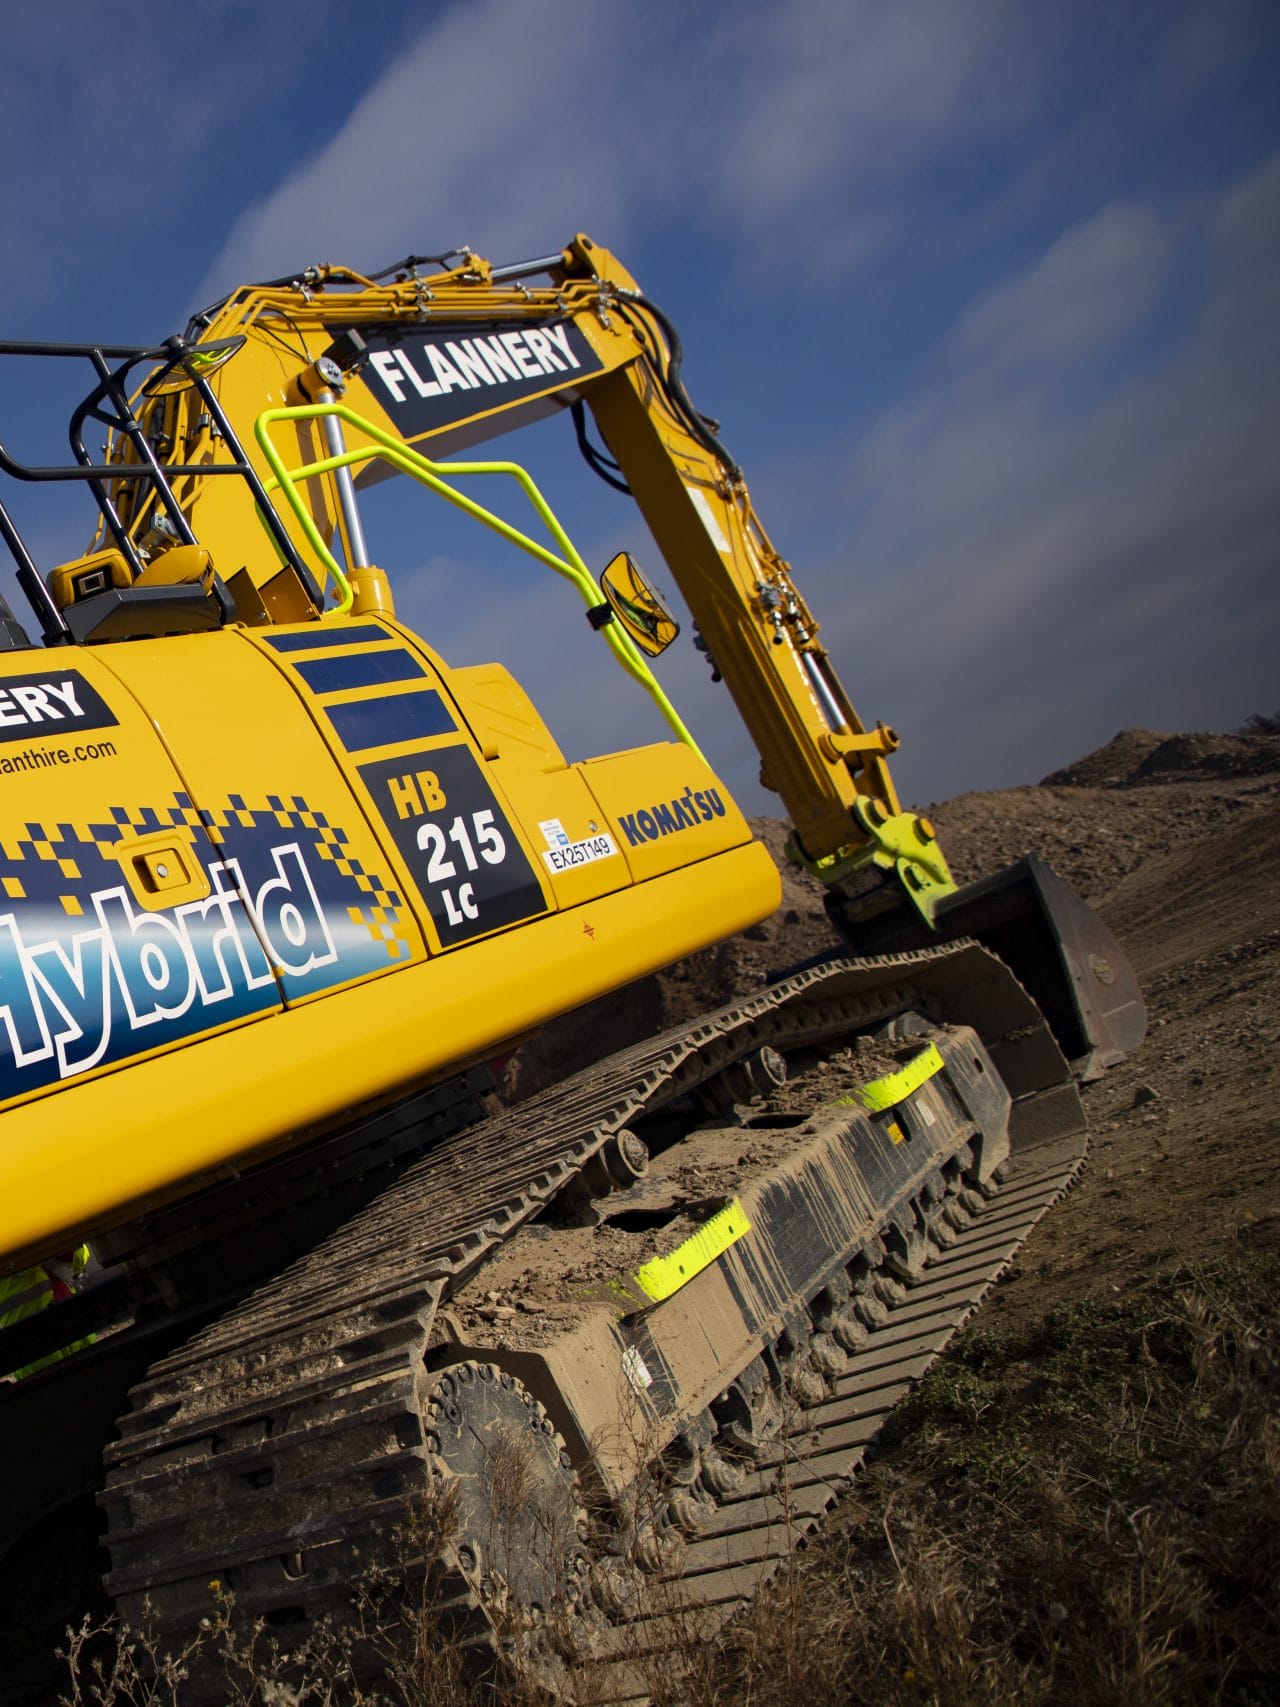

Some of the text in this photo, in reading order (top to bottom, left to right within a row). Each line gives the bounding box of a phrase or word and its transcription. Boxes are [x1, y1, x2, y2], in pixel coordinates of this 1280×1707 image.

[369, 324, 581, 402] FLANNERY
[387, 770, 447, 820] HB
[617, 786, 727, 847] KOMATSU
[416, 809, 506, 884] 215
[549, 836, 611, 870] EX25T149
[441, 882, 480, 927] LC
